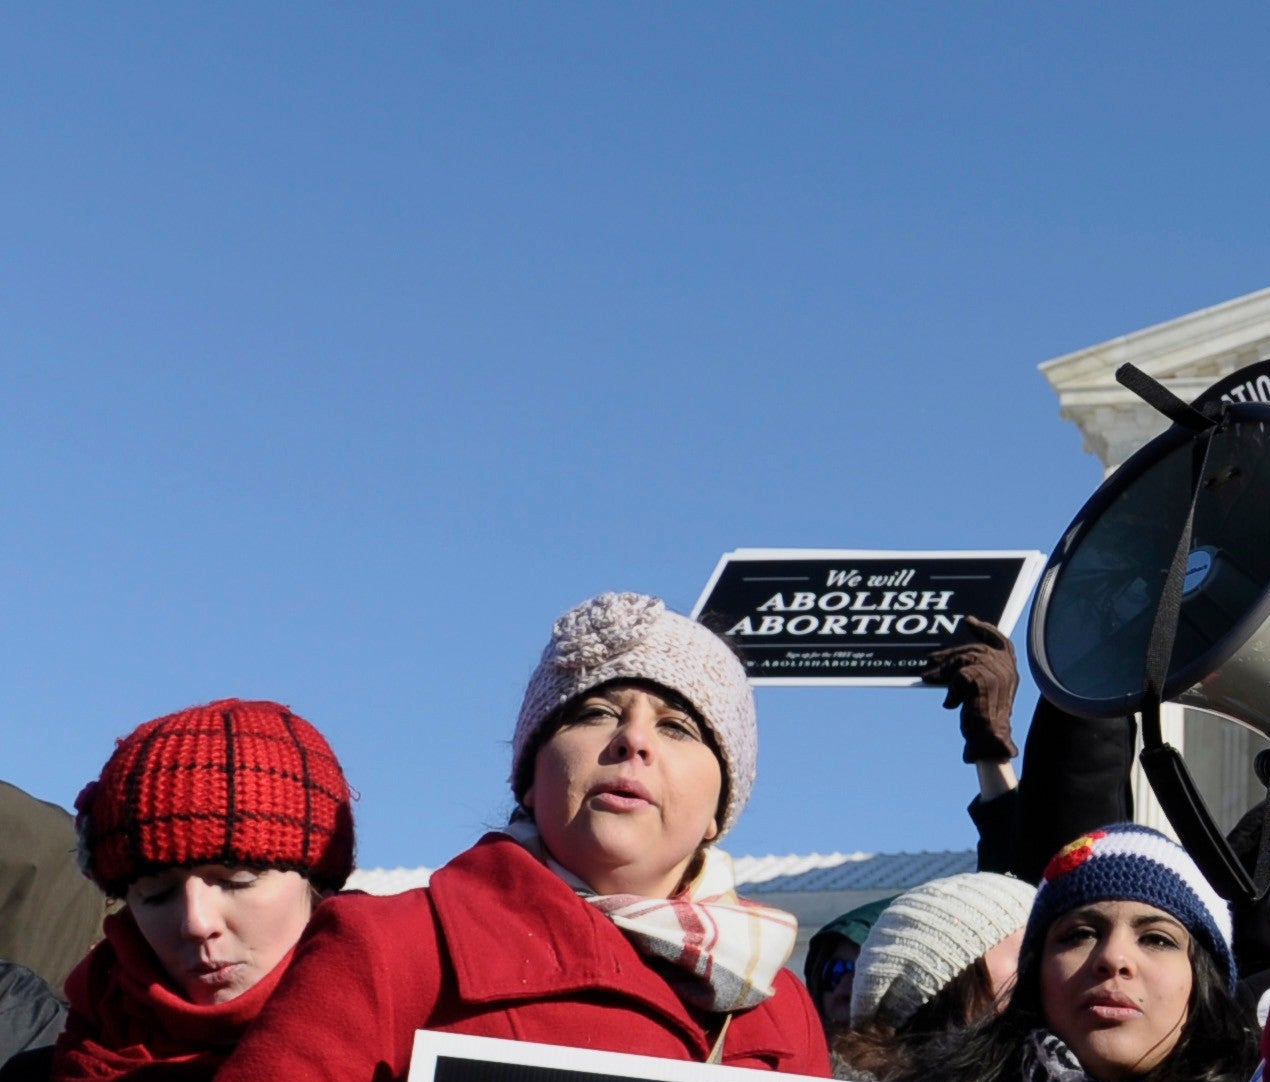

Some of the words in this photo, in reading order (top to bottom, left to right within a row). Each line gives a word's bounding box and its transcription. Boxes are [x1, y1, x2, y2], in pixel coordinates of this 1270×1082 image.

[825, 569, 862, 588] We
[867, 568, 916, 587] will
[756, 591, 955, 611] ABOLISH
[724, 614, 965, 637] ABORTION
